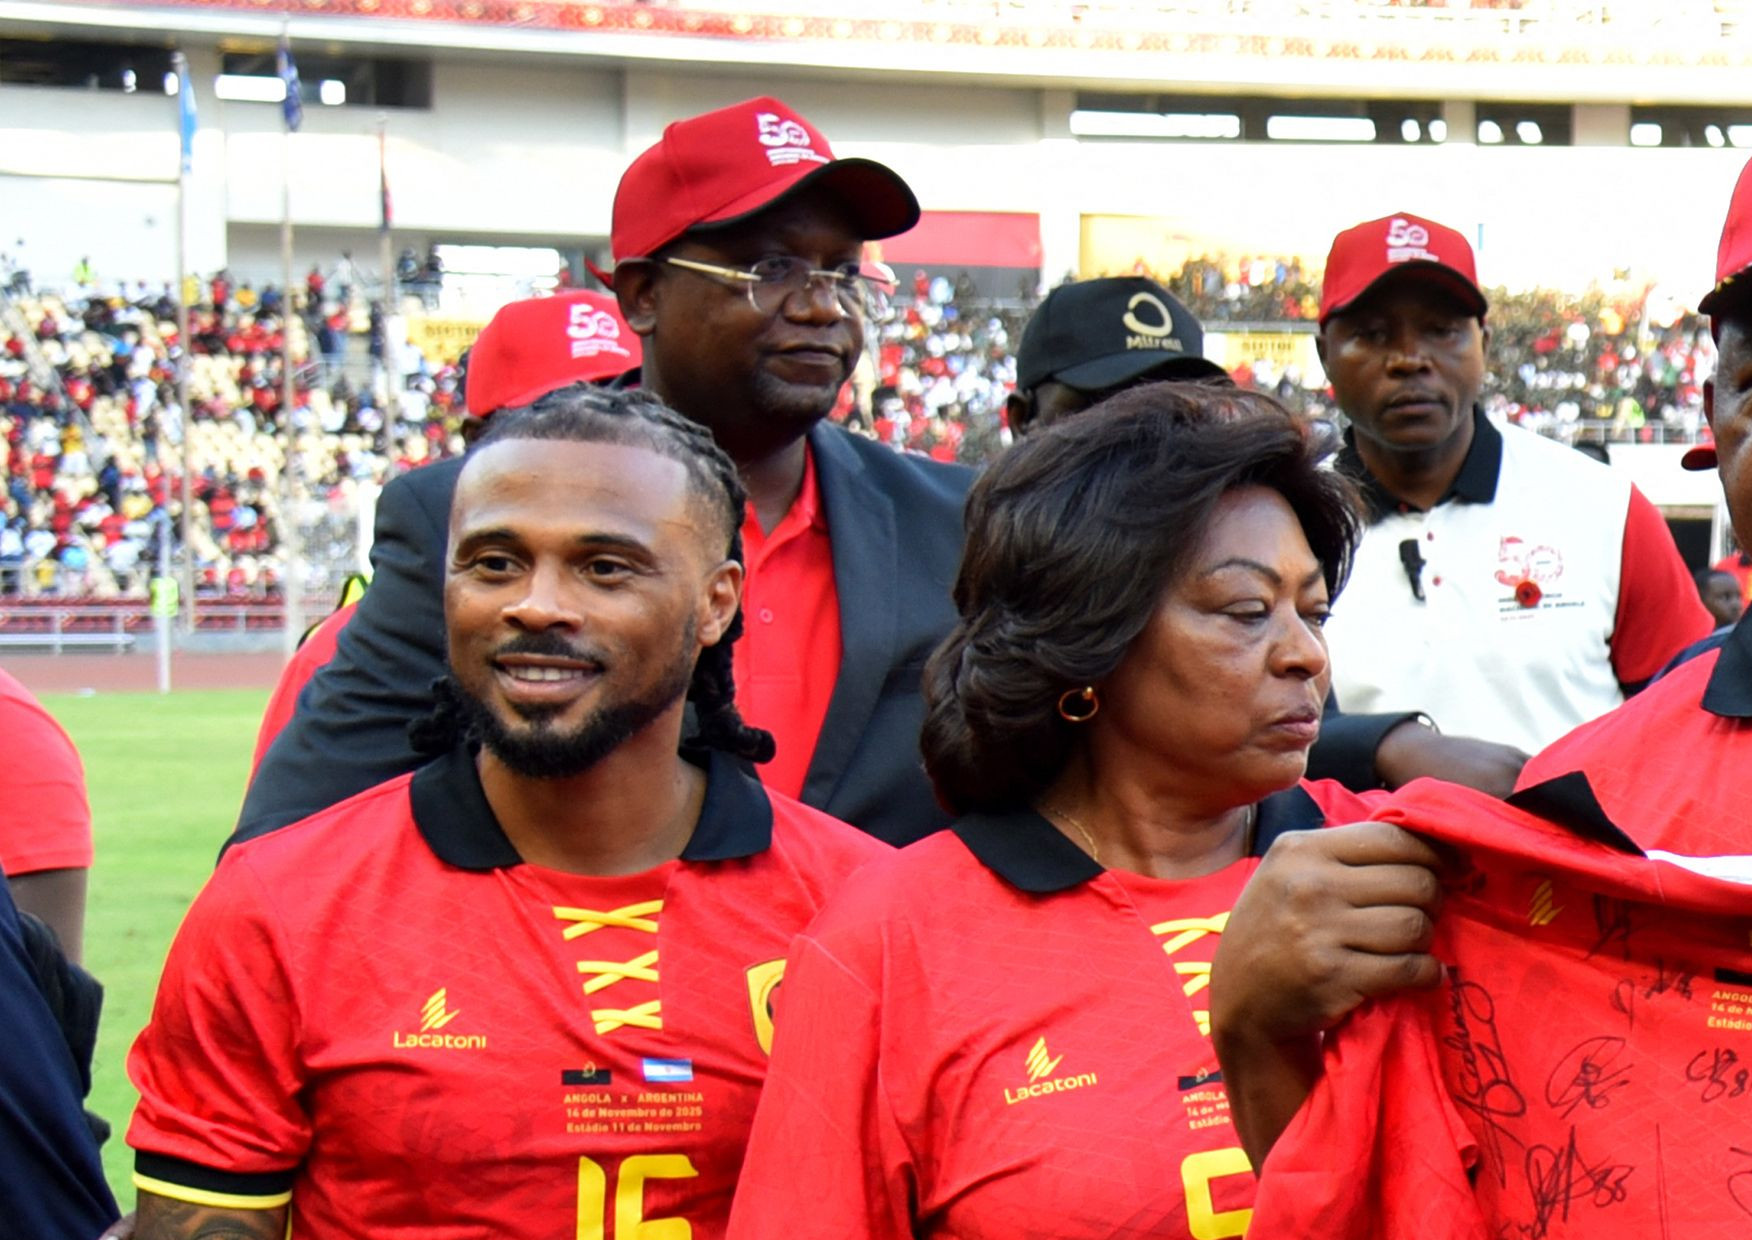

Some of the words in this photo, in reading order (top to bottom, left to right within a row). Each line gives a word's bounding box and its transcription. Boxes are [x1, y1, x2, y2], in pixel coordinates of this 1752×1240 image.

[1711, 1003, 1725, 1012] 14
[1727, 1004, 1743, 1015] de
[1706, 1016, 1752, 1031] Estádio
[393, 1031, 487, 1049] Lacatoni
[1004, 1072, 1098, 1105] Lacatoni
[564, 1092, 612, 1104] ANGOLA
[637, 1092, 704, 1103] ARGENTINA
[598, 1107, 657, 1118] Novembro
[613, 1122, 625, 1132] 11
[644, 1121, 702, 1132] Novembro
